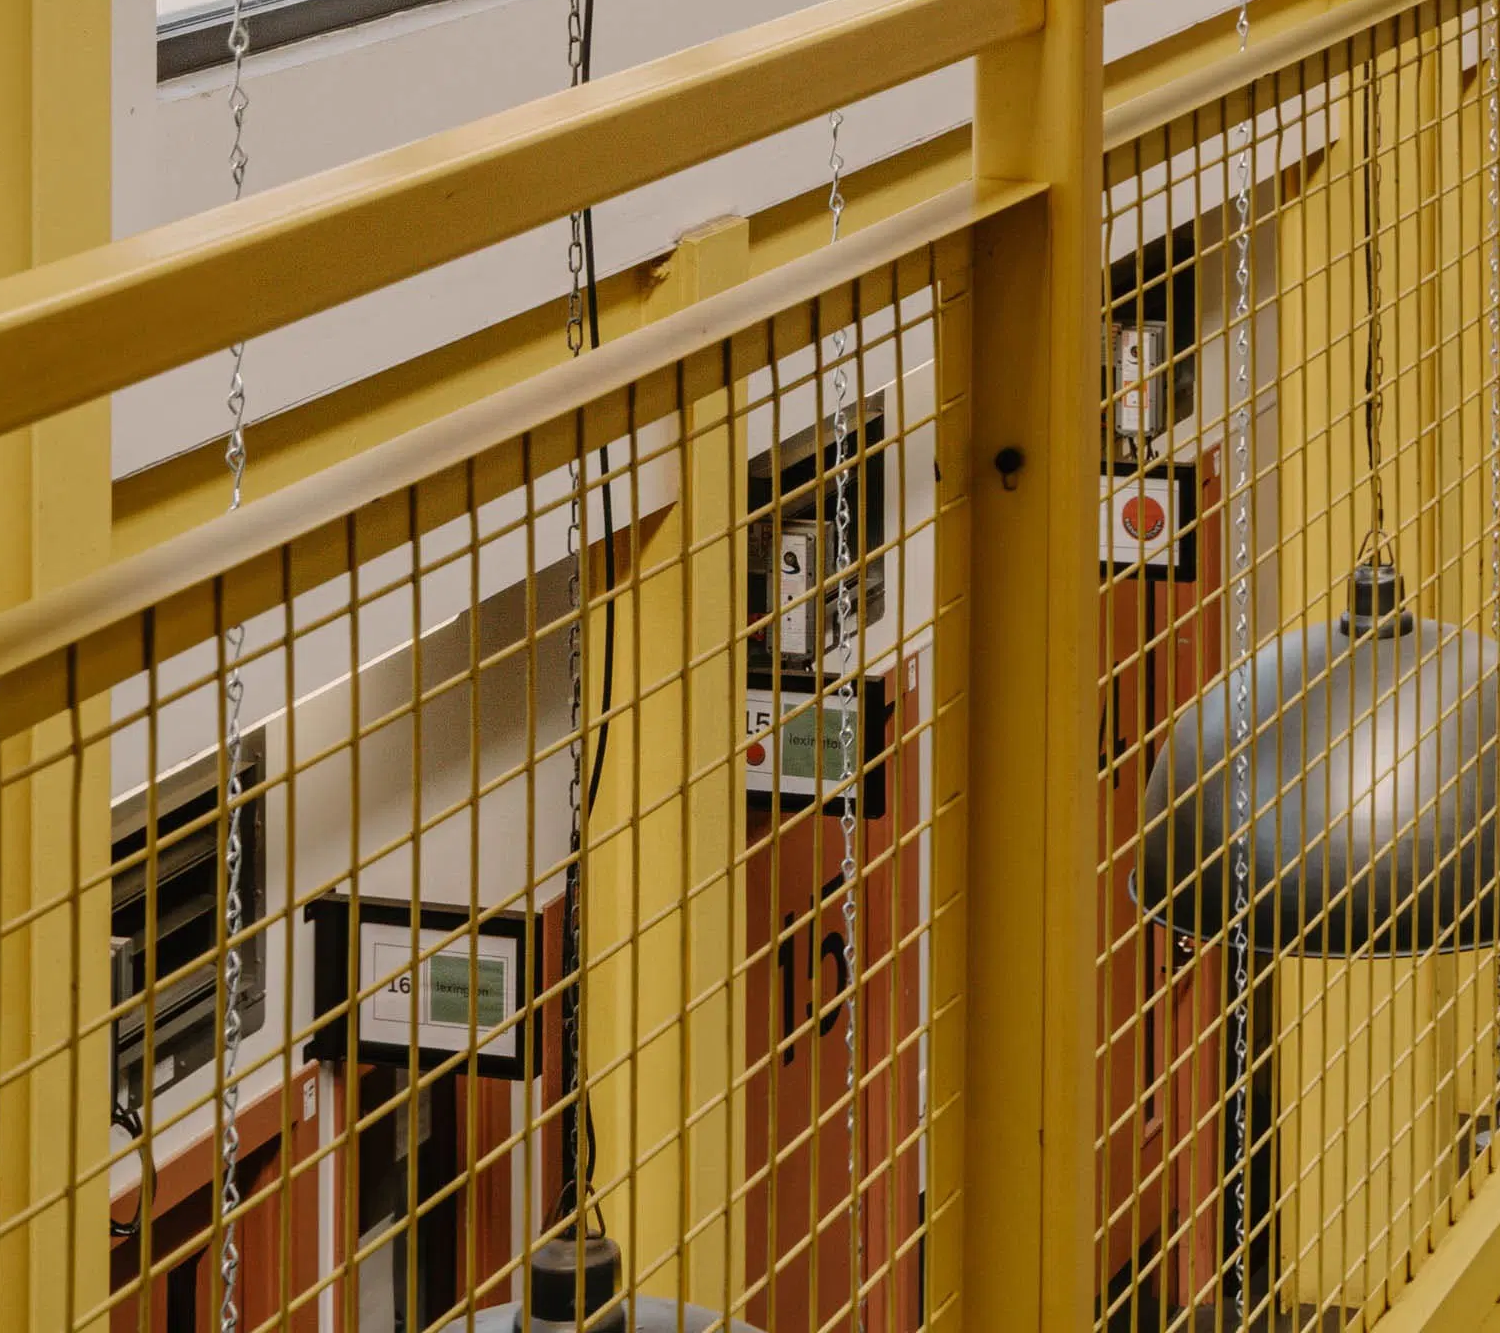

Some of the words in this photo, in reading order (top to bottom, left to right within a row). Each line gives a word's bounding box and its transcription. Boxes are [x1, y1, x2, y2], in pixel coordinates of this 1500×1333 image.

[778, 872, 848, 1067] 15
[388, 976, 412, 994] 16
[436, 980, 489, 998] lexingon
